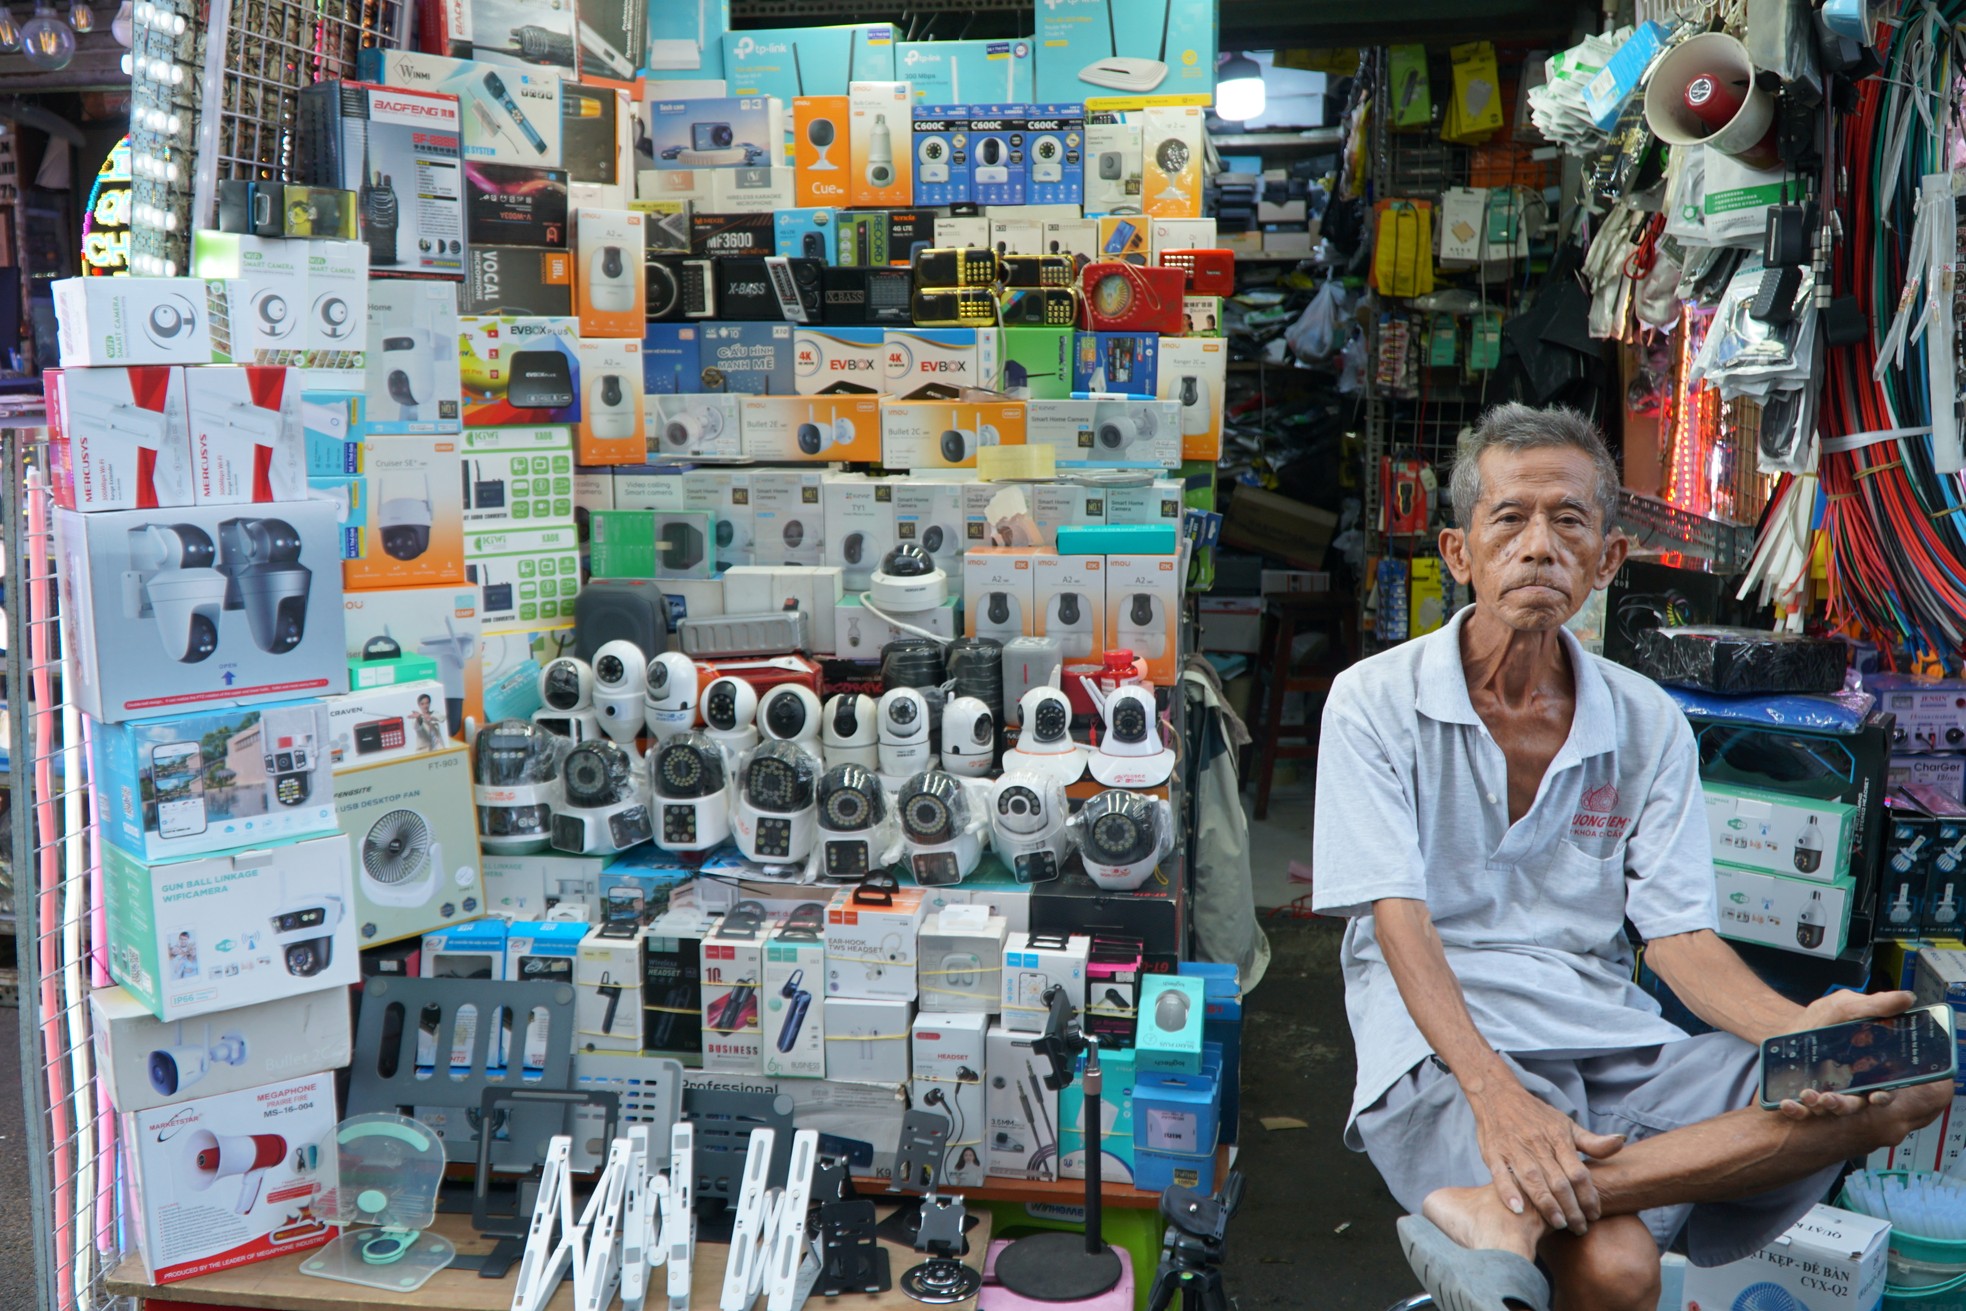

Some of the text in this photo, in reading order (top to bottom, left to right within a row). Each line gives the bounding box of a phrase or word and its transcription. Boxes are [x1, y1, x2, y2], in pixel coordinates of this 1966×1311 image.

[754, 42, 787, 56] tp-link
[374, 100, 438, 117] BAOFENG
[914, 121, 945, 130] C600C
[971, 121, 1002, 130] C600C
[1027, 121, 1059, 130] C600C
[812, 182, 837, 194] Cue
[707, 232, 753, 248] MF3600
[874, 215, 884, 263] RECORD
[552, 259, 564, 279] JBL
[483, 250, 499, 301] VOCAL
[728, 282, 766, 295] X-BASS
[510, 326, 568, 336] EVBOX PLUS
[717, 342, 774, 359] CẤU HÌNH
[799, 351, 812, 361] 4K
[888, 353, 903, 363] 4K
[717, 358, 774, 373] MẠNH MẼ
[830, 359, 875, 371] EVBOX
[920, 360, 967, 373] EVBOX
[746, 420, 778, 428] Bullet 2E
[1066, 415, 1089, 423] Camera
[888, 427, 921, 437] Bullet 2C
[199, 432, 212, 498] MERCUSYS
[375, 459, 402, 468] Cruiser
[79, 436, 93, 503] MERCUSYS
[626, 481, 671, 490] Video calling
[624, 488, 645, 496] Smart
[851, 504, 866, 512] TY1
[1110, 560, 1131, 568] imou
[991, 575, 1002, 584] A2
[1062, 576, 1073, 584] A2
[1135, 576, 1146, 585] A2
[219, 662, 238, 670] OPEN
[329, 706, 363, 717] CRAVEN
[428, 758, 459, 771] FT-903
[1913, 762, 1960, 772] CharGer
[1862, 776, 1870, 808] HEADSET
[340, 789, 421, 813] USB DESKTOP FAN
[161, 869, 259, 893] GUN BALL LINKAGE
[162, 884, 229, 903] WIFICAMERA
[828, 938, 866, 946] EAR-HOOK
[847, 945, 883, 954] HEADSET
[648, 969, 681, 978] HEADSET
[173, 994, 195, 1004] IP66
[708, 1043, 759, 1055] BUSINESS
[937, 1053, 969, 1061] HEADSET
[790, 1062, 821, 1071] BUSINESS
[1153, 1060, 1186, 1068] logitech
[256, 1083, 317, 1102] MEGAPHONE
[266, 1093, 309, 1108] PRAIRIE FIRE
[263, 1101, 314, 1119] MS-16-004
[149, 1115, 199, 1132] MARKETSTAR
[876, 1167, 892, 1178] K9
[163, 1266, 199, 1280] PRODUCED
[208, 1262, 221, 1270] THE
[222, 1256, 246, 1267] LEADER
[256, 1244, 295, 1259] MEGAPHONE
[295, 1235, 326, 1249] INDUSTRY
[1767, 1251, 1794, 1269] KẸP
[1823, 1265, 1850, 1282] BÀN
[1800, 1277, 1849, 1297] CYX-Q2
